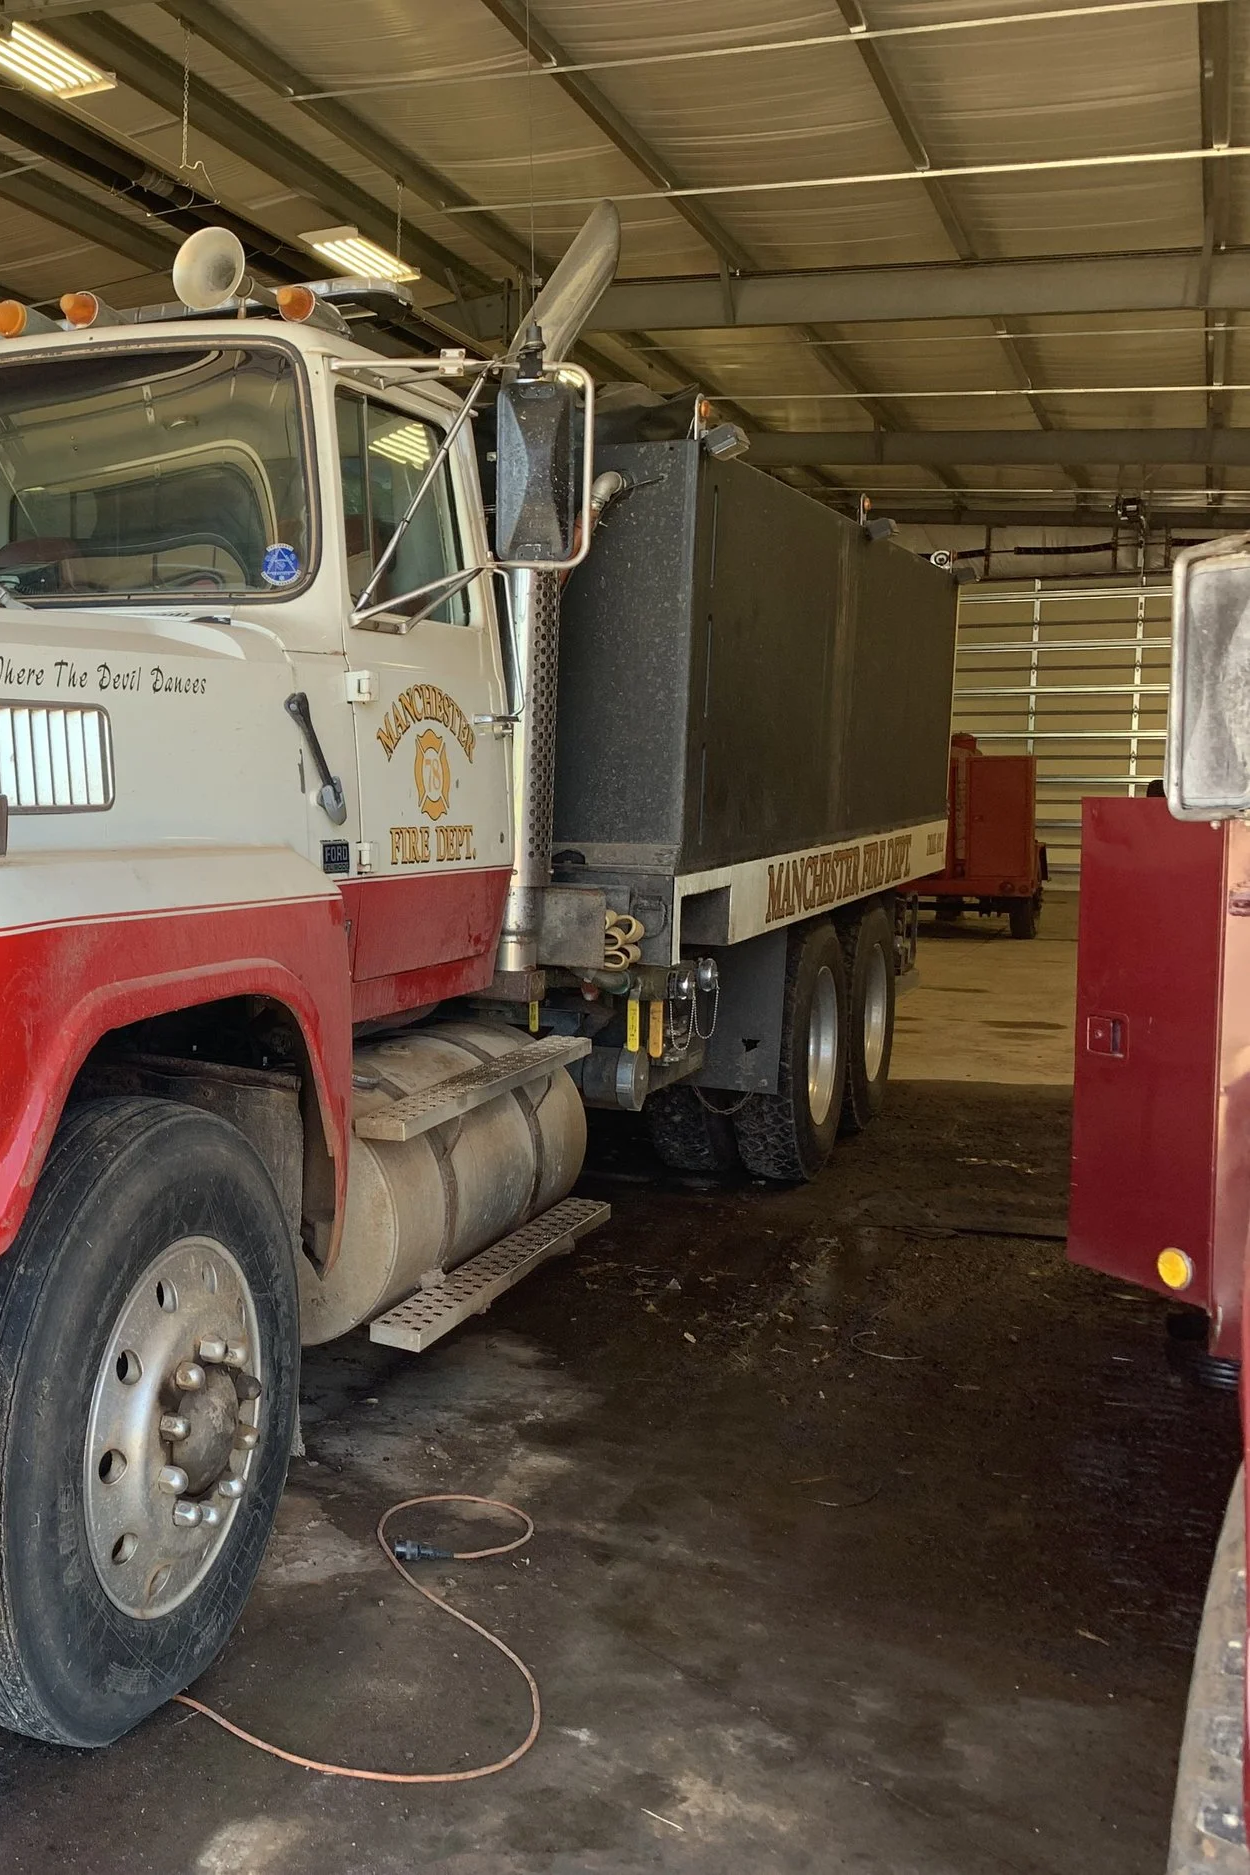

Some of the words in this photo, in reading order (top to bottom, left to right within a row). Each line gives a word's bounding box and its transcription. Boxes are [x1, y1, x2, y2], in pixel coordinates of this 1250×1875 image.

[54, 659, 88, 689] The
[97, 662, 141, 693] Devil
[151, 666, 207, 695] Dances
[376, 684, 477, 764] MANCHESTER
[425, 757, 442, 793] 78
[325, 845, 348, 862] FORD
[389, 826, 431, 865] FIRE
[435, 825, 477, 861] DEPT.
[765, 846, 861, 924] MANCHESTER
[860, 840, 886, 892] FIRE
